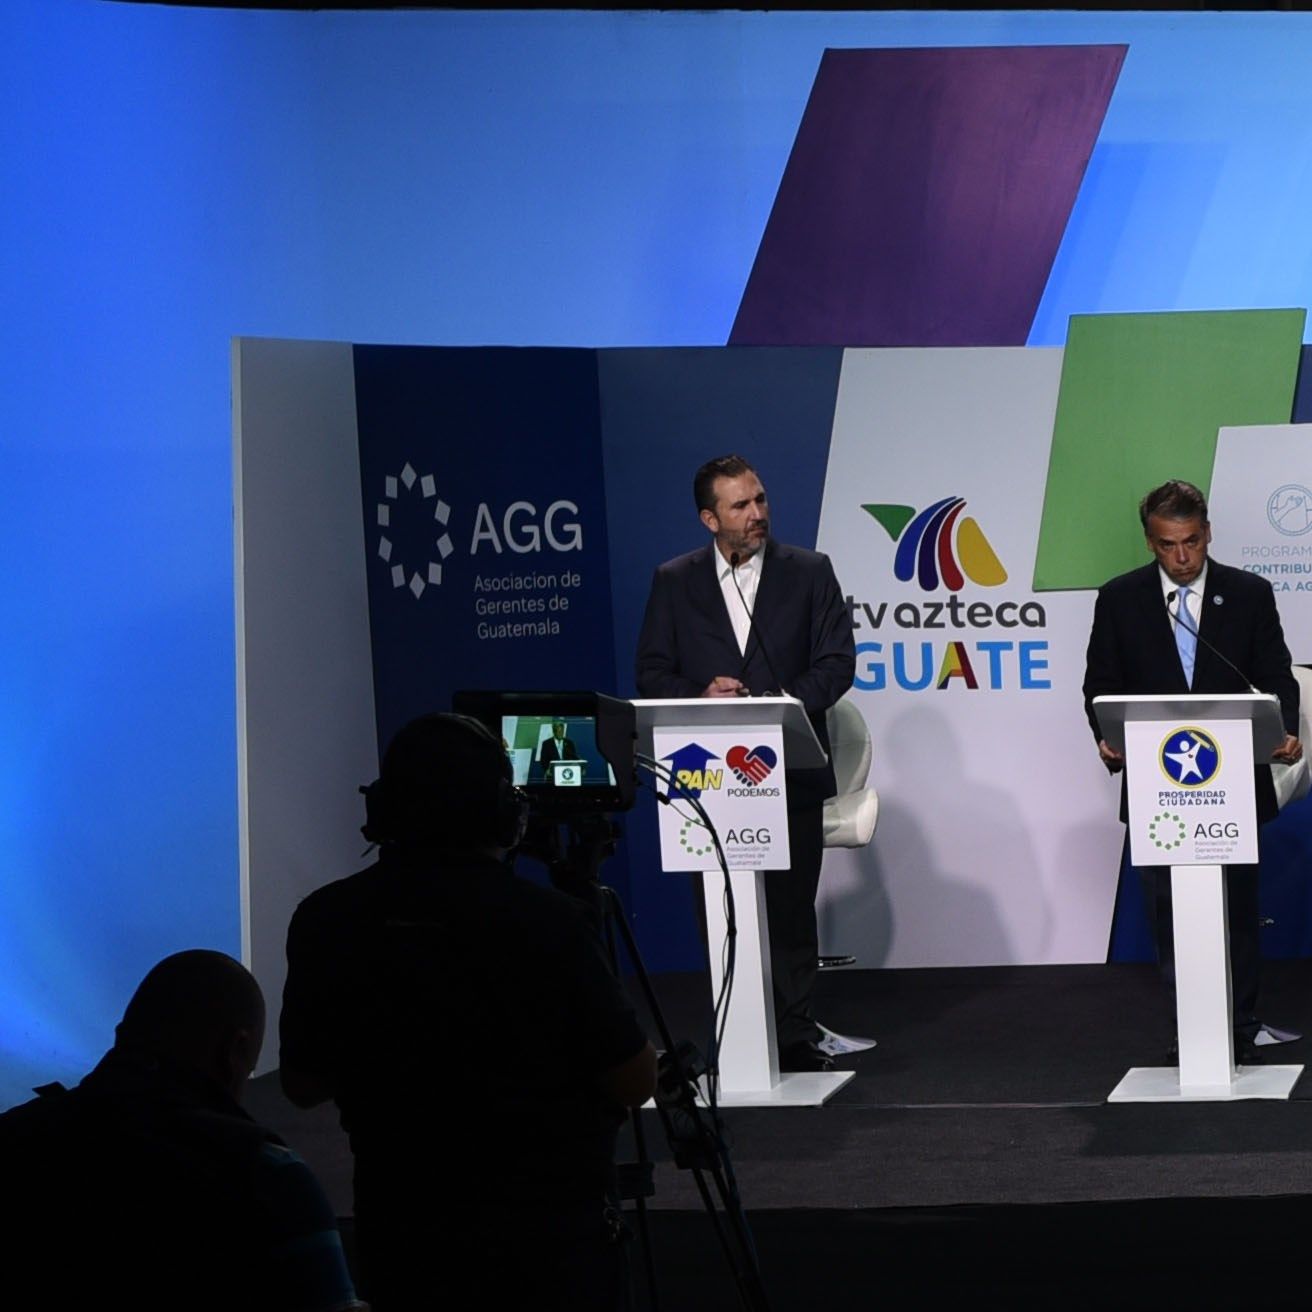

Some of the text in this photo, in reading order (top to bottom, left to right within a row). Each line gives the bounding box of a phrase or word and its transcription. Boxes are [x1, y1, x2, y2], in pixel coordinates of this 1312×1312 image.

[470, 500, 583, 554] AGG
[561, 569, 581, 588] de
[475, 594, 569, 616] Gerentes de
[846, 595, 1046, 629] tv azteca
[477, 618, 560, 640] Guatemala
[853, 641, 1051, 691] GUATE
[675, 769, 723, 791] PAN
[727, 787, 780, 797] PODEMOS
[1158, 790, 1226, 798] PROSPERIDAD
[1158, 798, 1226, 806] CIUDADANA
[726, 828, 771, 844] AGG
[1194, 822, 1239, 838] AGG
